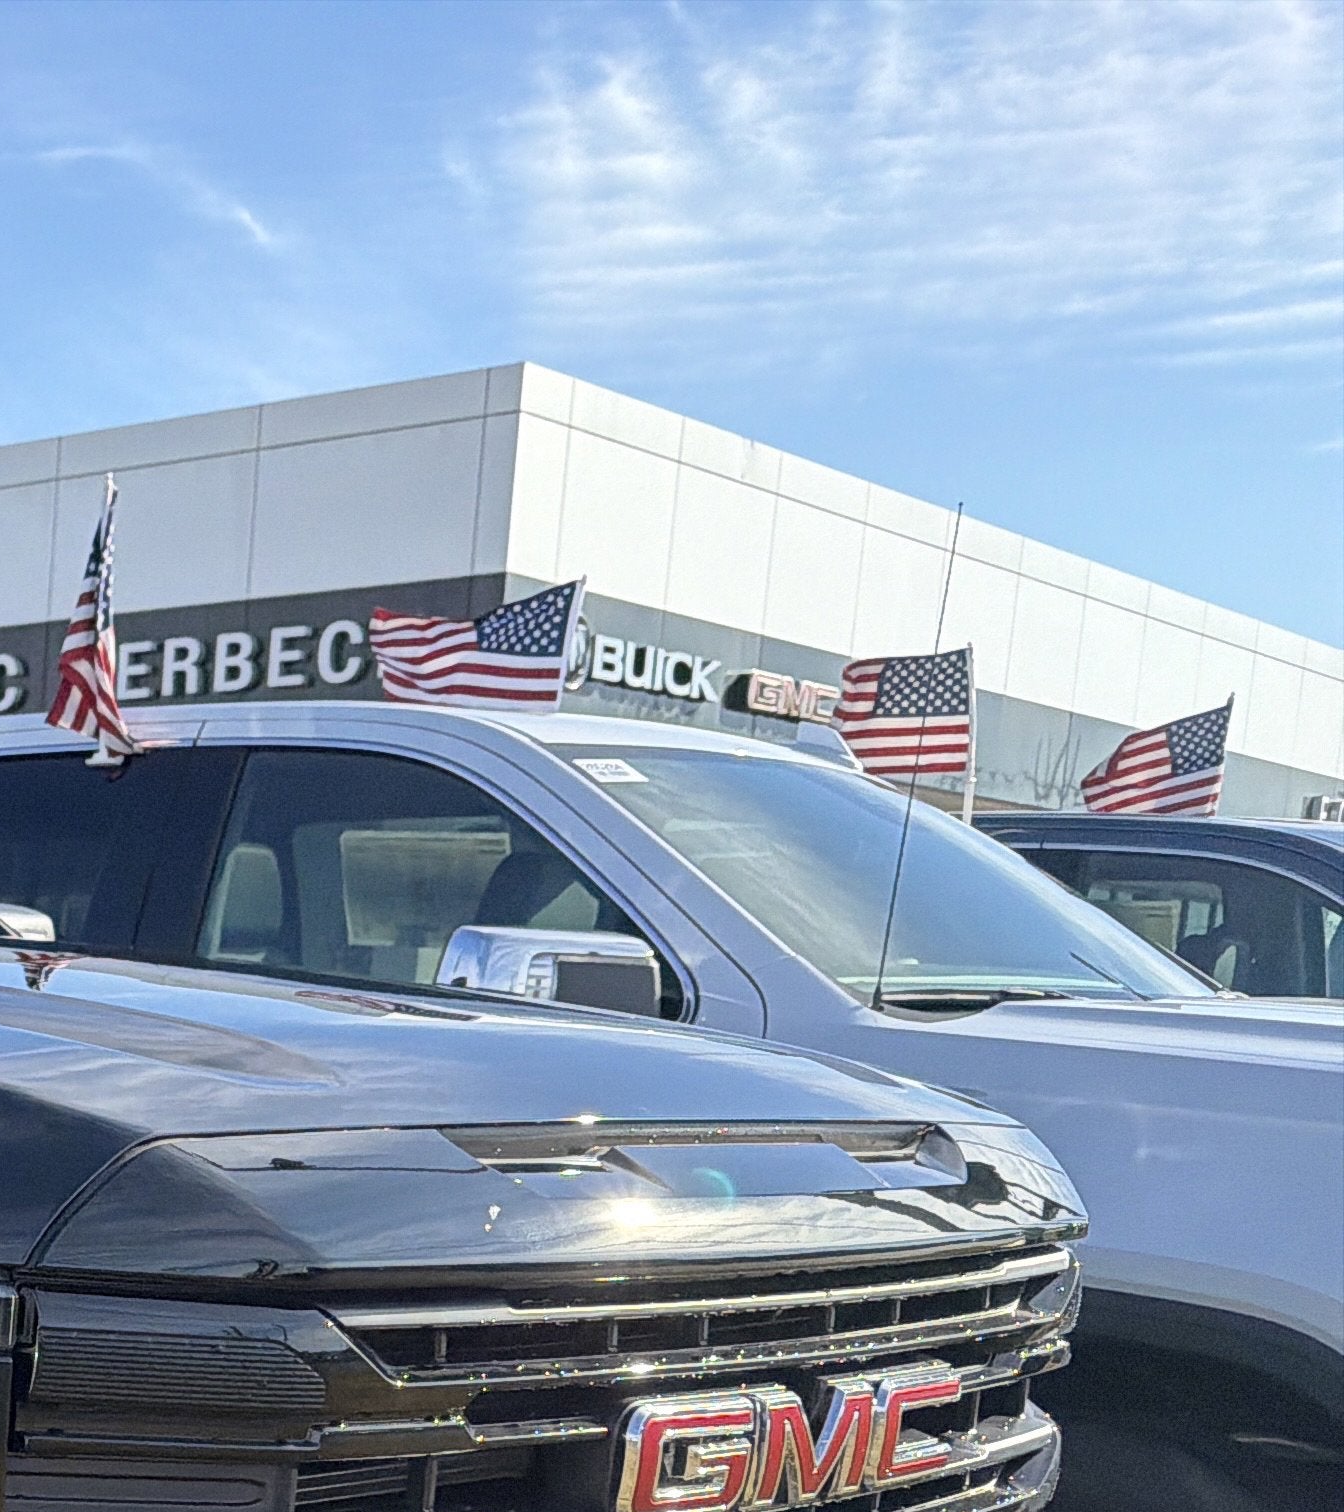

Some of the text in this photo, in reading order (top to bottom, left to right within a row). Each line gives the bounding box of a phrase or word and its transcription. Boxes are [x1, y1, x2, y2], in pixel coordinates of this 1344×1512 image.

[116, 619, 384, 700] ERBEC
[591, 634, 722, 703] BUICK
[747, 668, 842, 724] GMC
